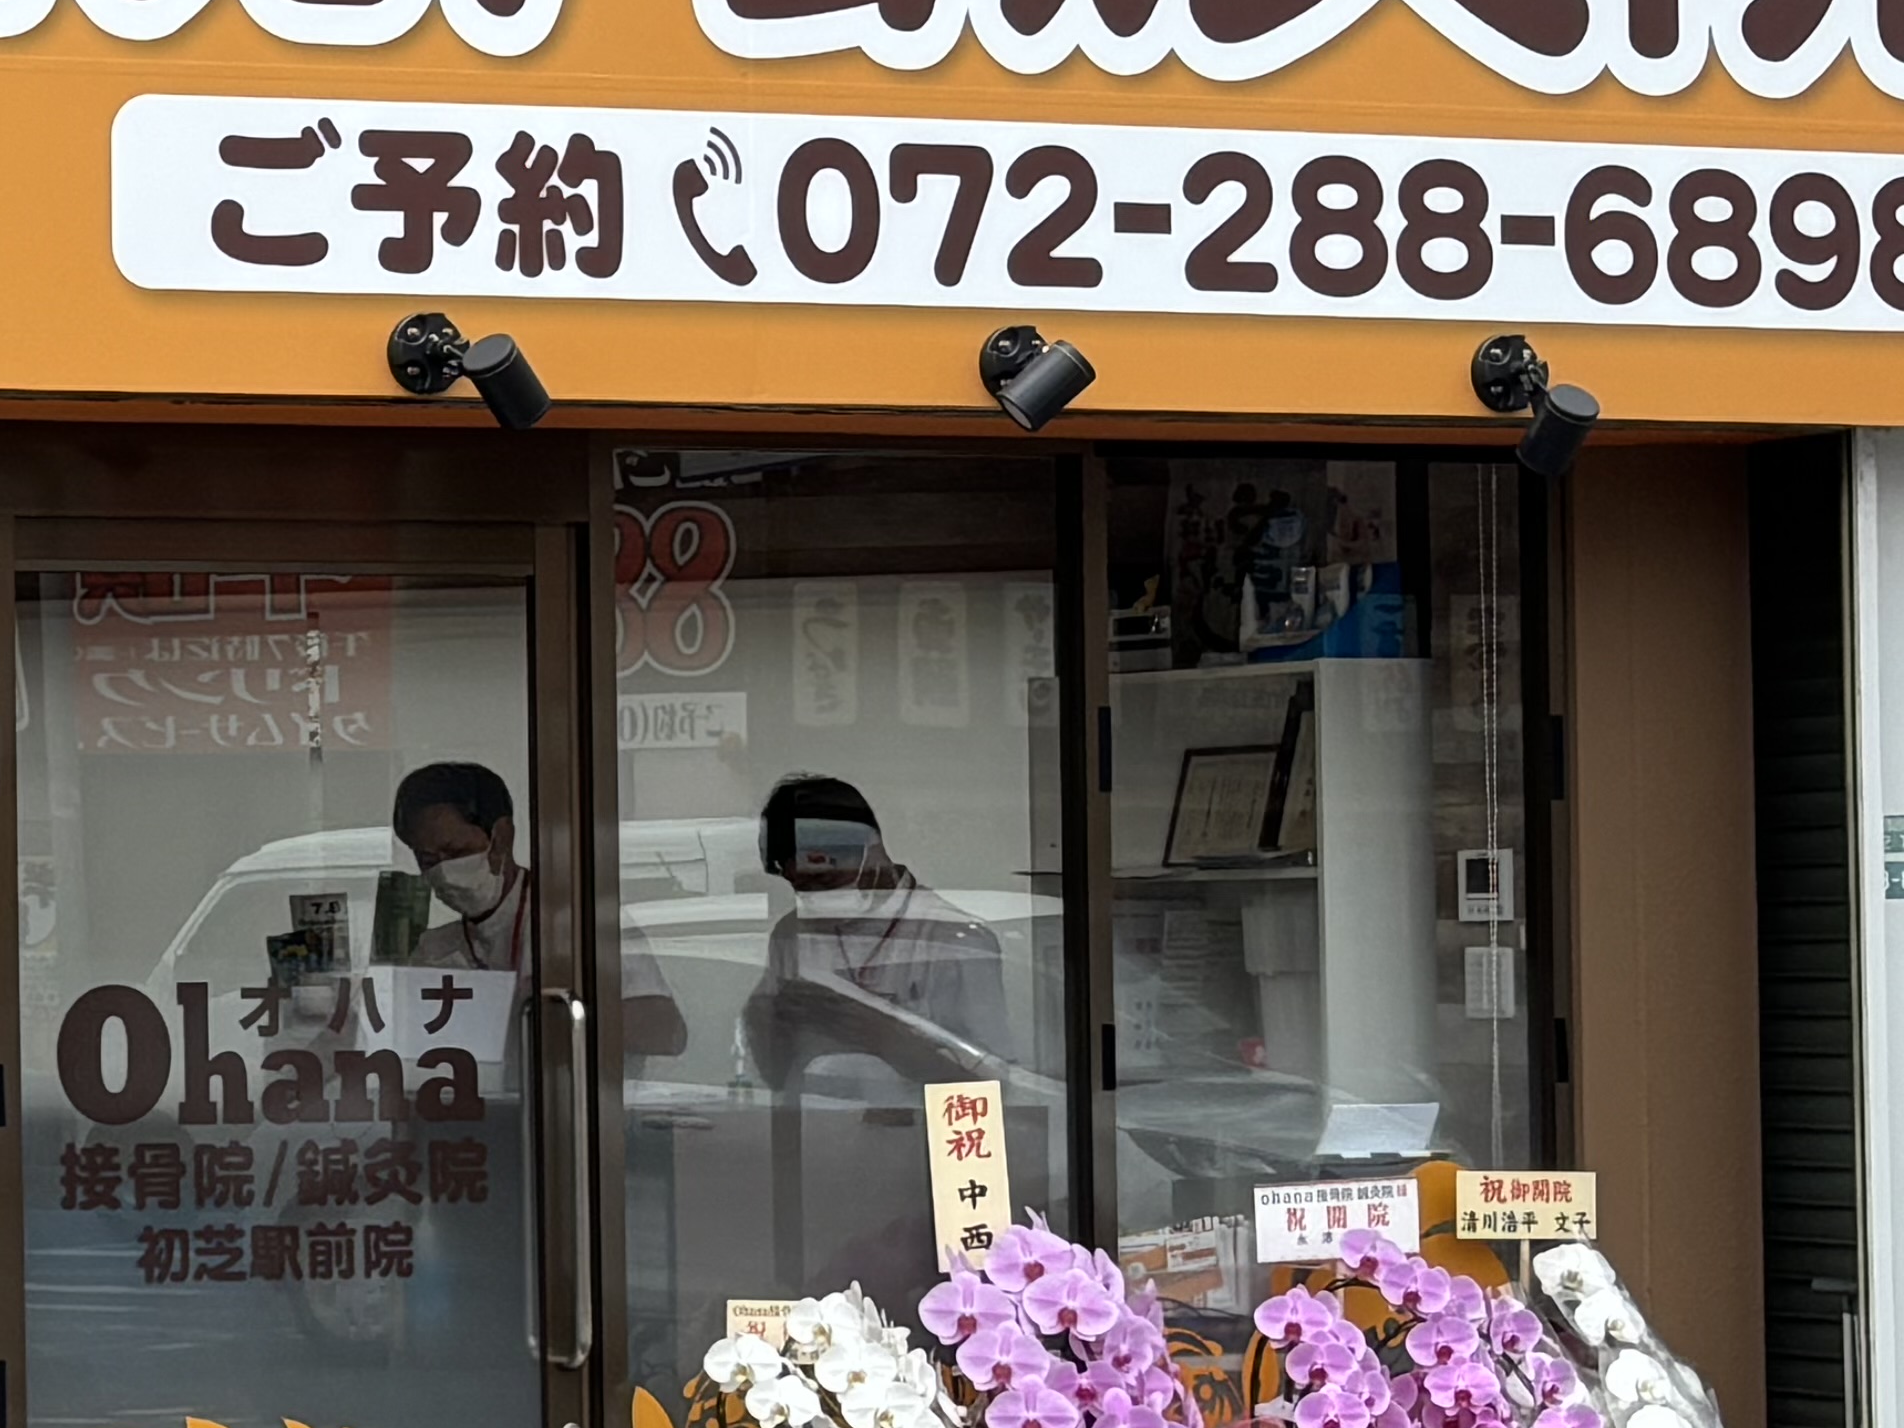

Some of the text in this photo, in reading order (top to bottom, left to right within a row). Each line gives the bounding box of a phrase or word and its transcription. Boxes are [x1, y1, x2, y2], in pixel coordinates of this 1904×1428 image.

[206, 123, 628, 288] ご予約
[56, 983, 486, 1126] Ohana
[238, 974, 474, 1038] オハナ
[941, 1094, 994, 1252] 御祝 中西
[136, 1224, 415, 1284] 初芝駅前院
